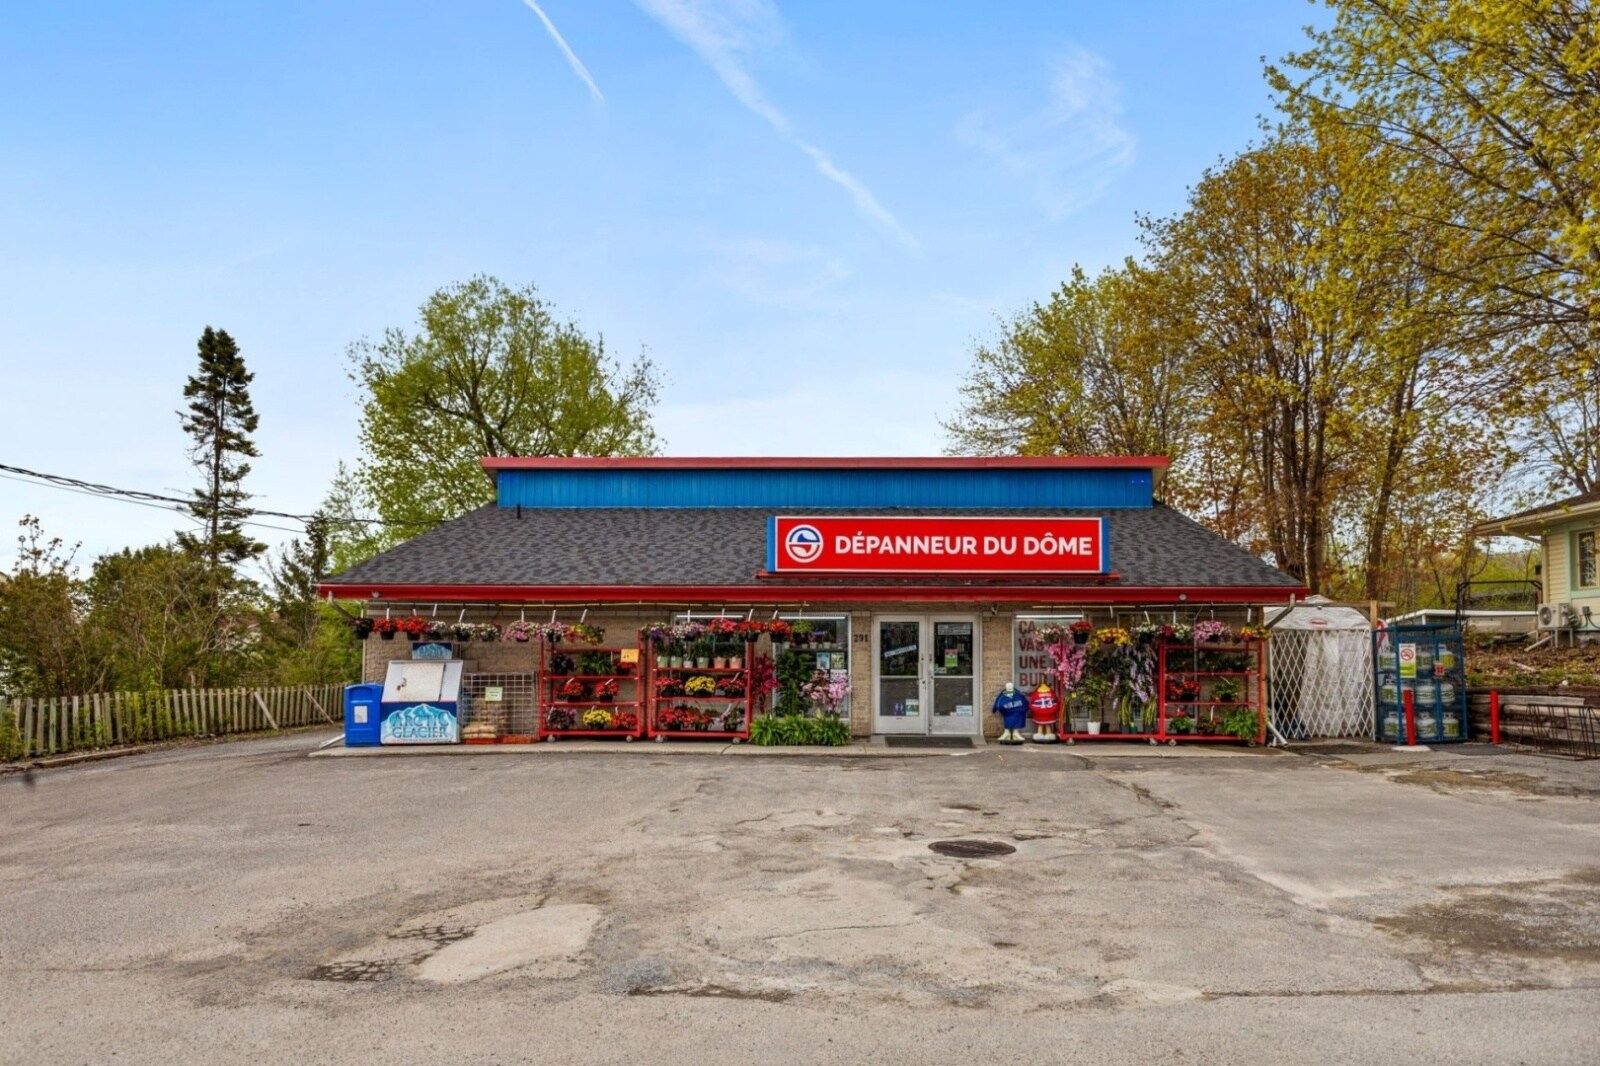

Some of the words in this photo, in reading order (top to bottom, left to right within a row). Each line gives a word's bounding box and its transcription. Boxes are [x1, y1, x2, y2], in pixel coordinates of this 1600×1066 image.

[835, 531, 978, 555] DÉPANNEUR
[983, 536, 1017, 555] DU
[1023, 532, 1093, 555] DÔME
[1018, 620, 1036, 637] ÇA
[853, 633, 868, 643] 291
[1018, 655, 1047, 669] UNE
[391, 711, 449, 727] ARCTIC
[391, 726, 449, 738] GLACIER
